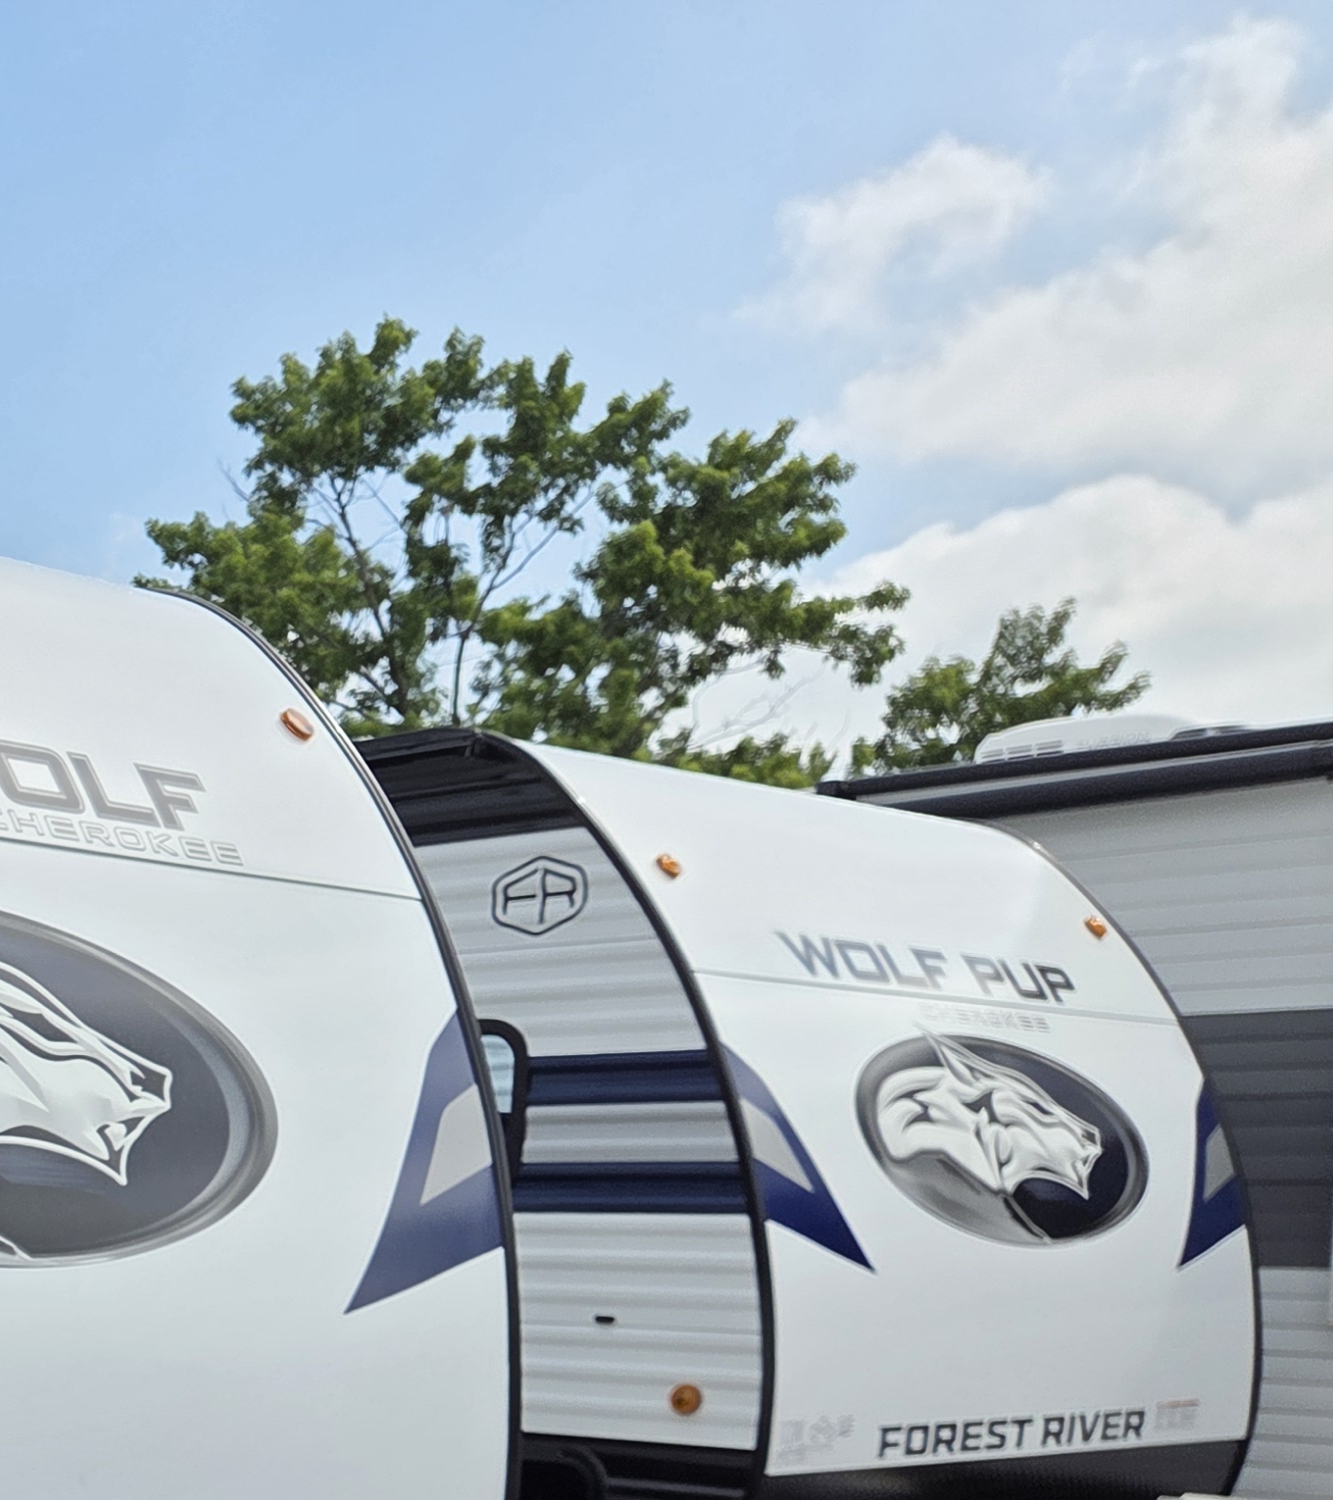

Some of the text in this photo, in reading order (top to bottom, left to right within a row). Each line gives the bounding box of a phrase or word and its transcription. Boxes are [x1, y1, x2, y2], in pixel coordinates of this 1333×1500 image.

[773, 930, 1076, 1006] WOLF PUP
[877, 1418, 1033, 1459] FOREST
[1040, 1410, 1145, 1447] RIVER
